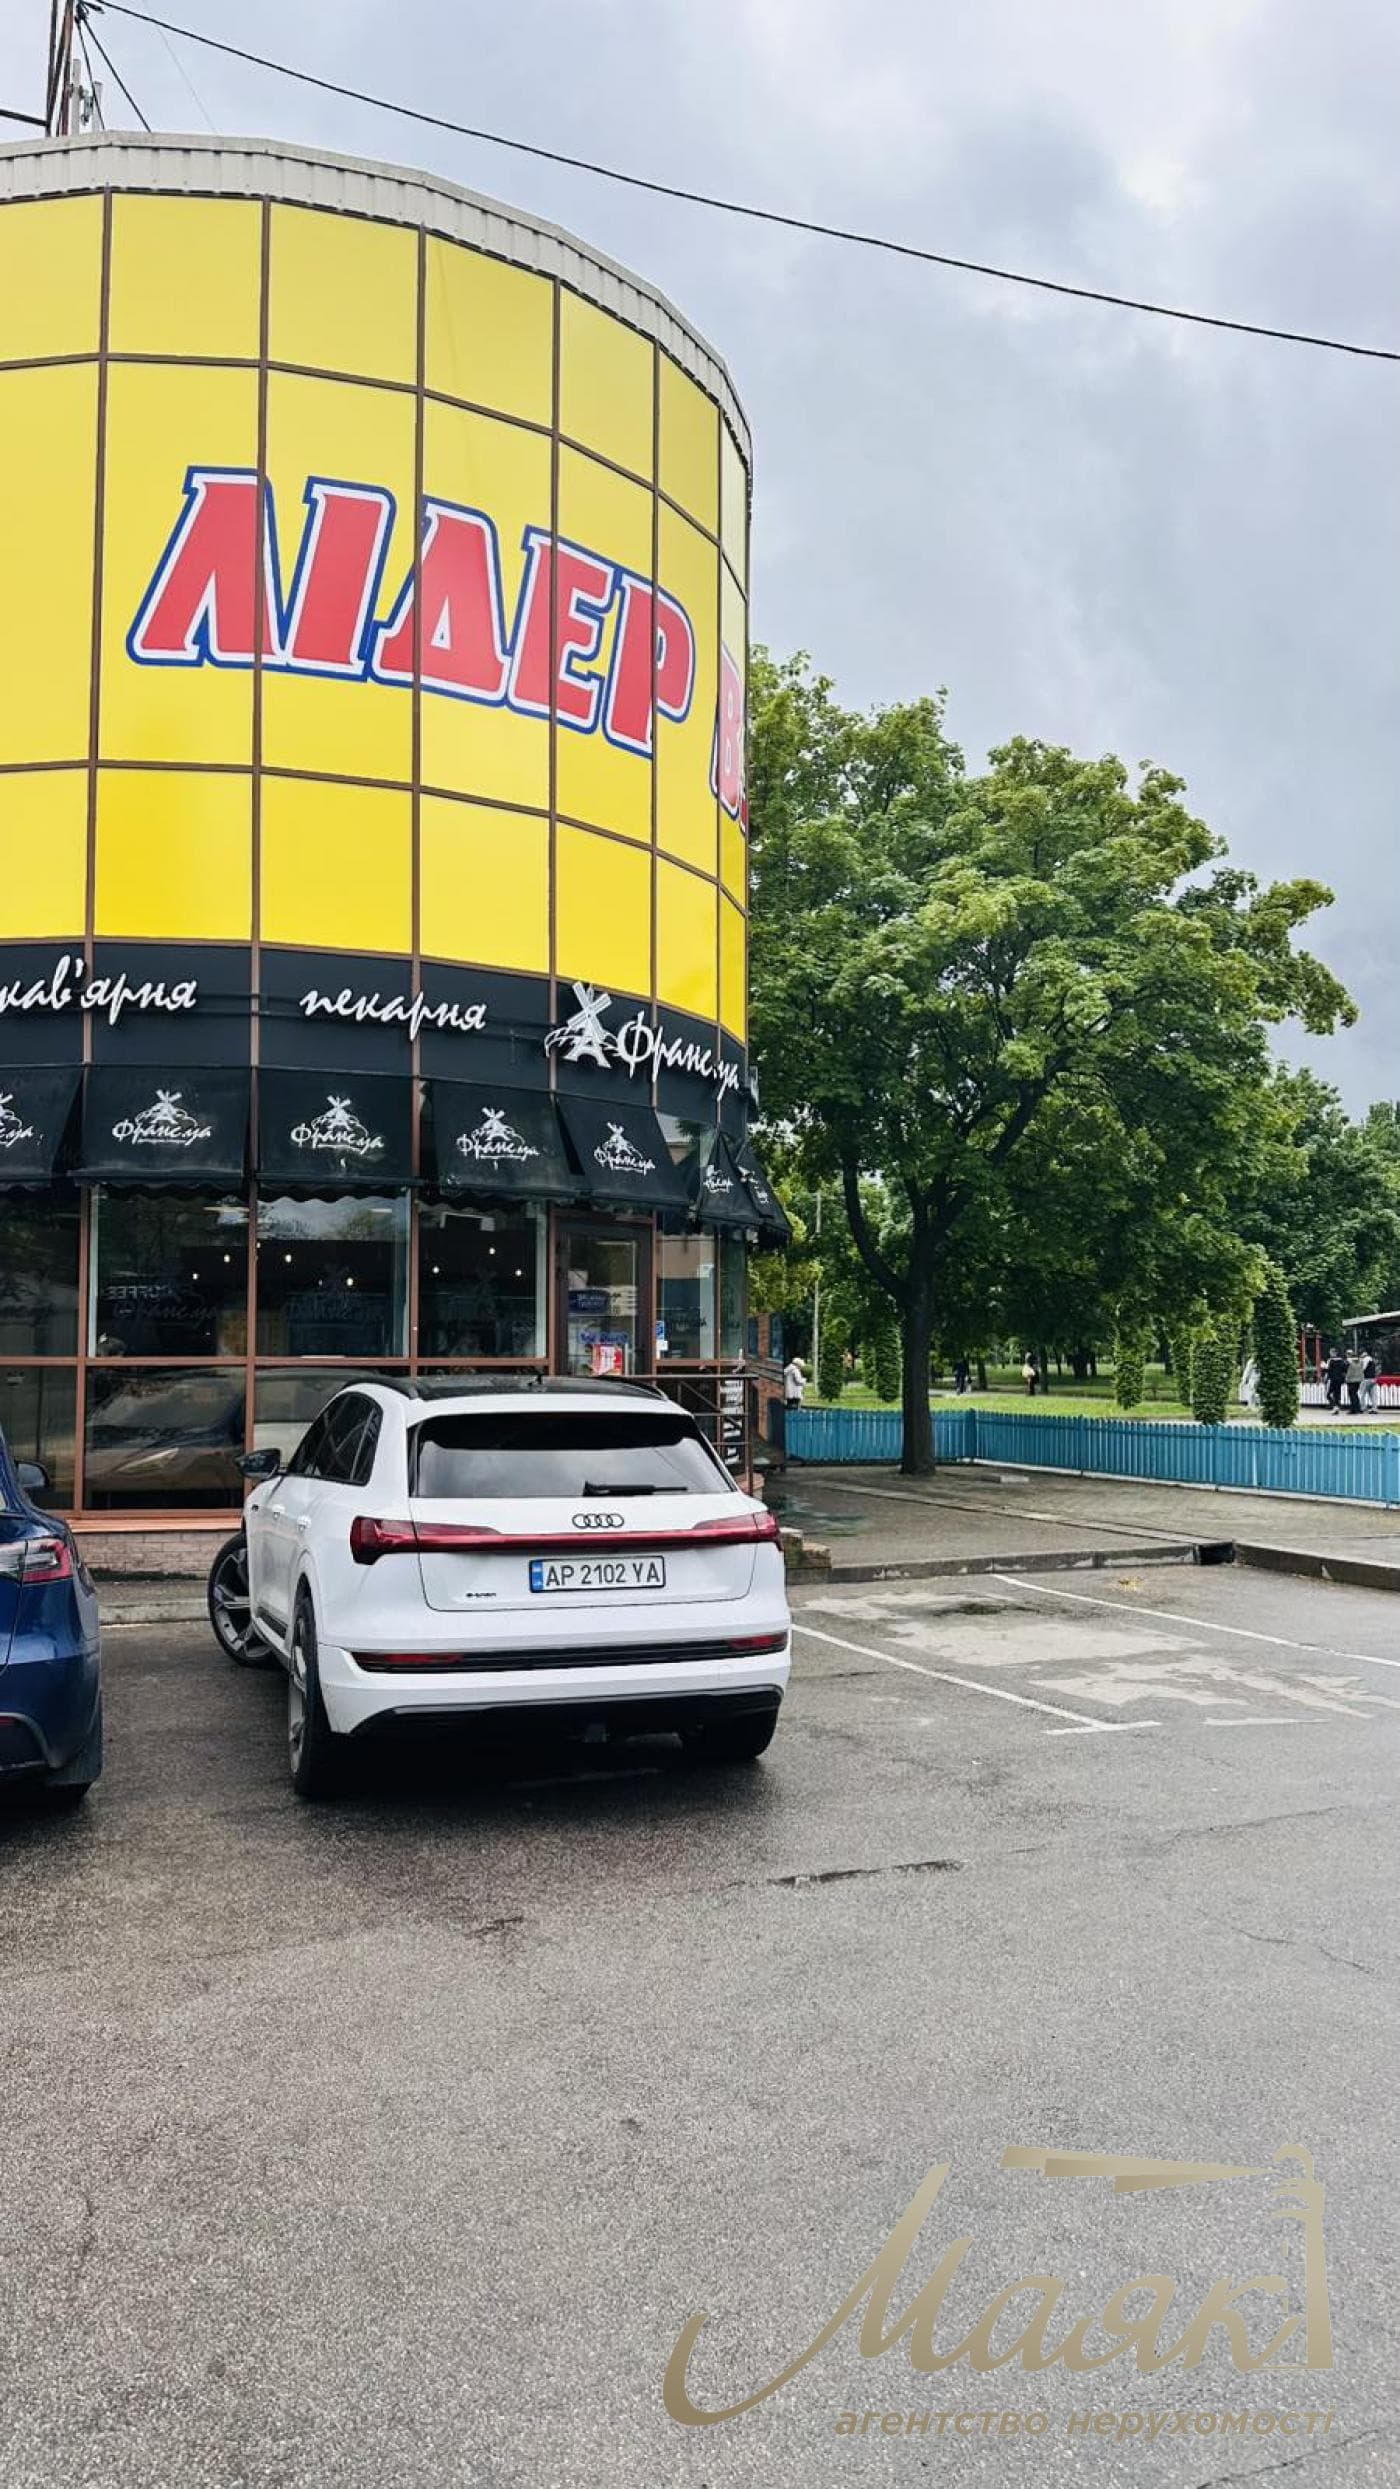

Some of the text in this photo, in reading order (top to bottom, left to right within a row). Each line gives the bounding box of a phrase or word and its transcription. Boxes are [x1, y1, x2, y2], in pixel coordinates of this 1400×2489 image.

[126, 465, 696, 758] ЛІДЕР
[299, 988, 487, 1042] пекарня
[546, 1561, 660, 1586] AP 2102 YA
